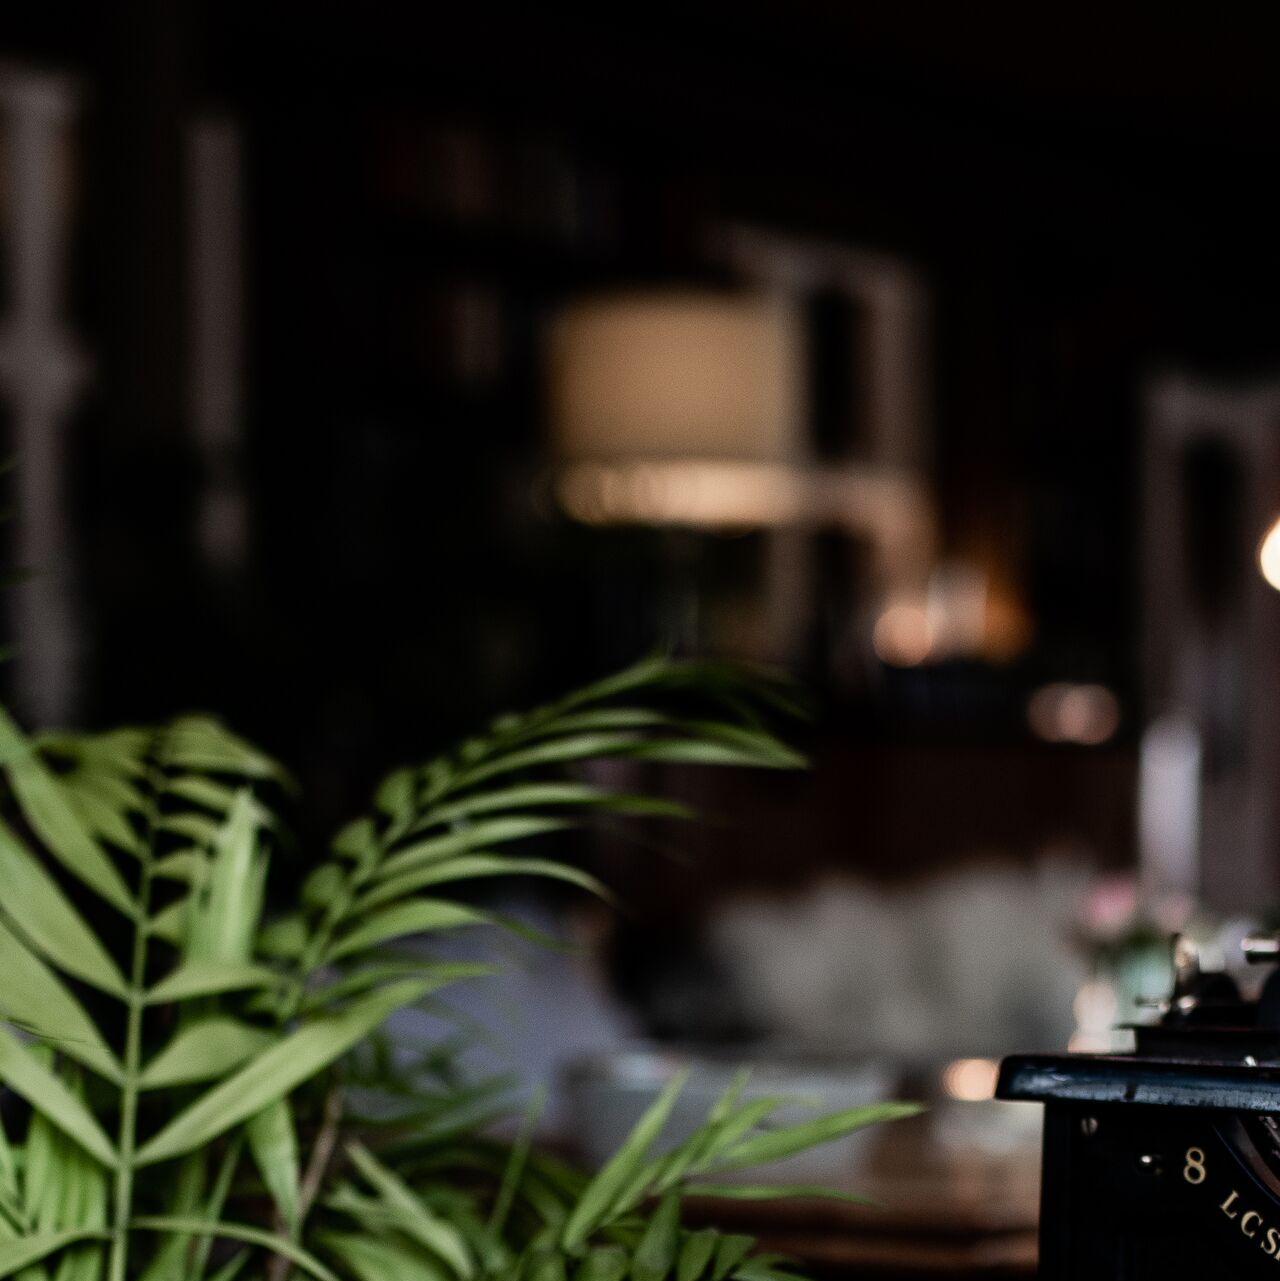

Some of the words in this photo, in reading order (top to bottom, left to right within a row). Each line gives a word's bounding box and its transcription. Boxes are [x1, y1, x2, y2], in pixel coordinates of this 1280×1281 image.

[1182, 1147, 1207, 1186] 8
[1220, 1190, 1239, 1219] L
[1240, 1210, 1262, 1239] C
